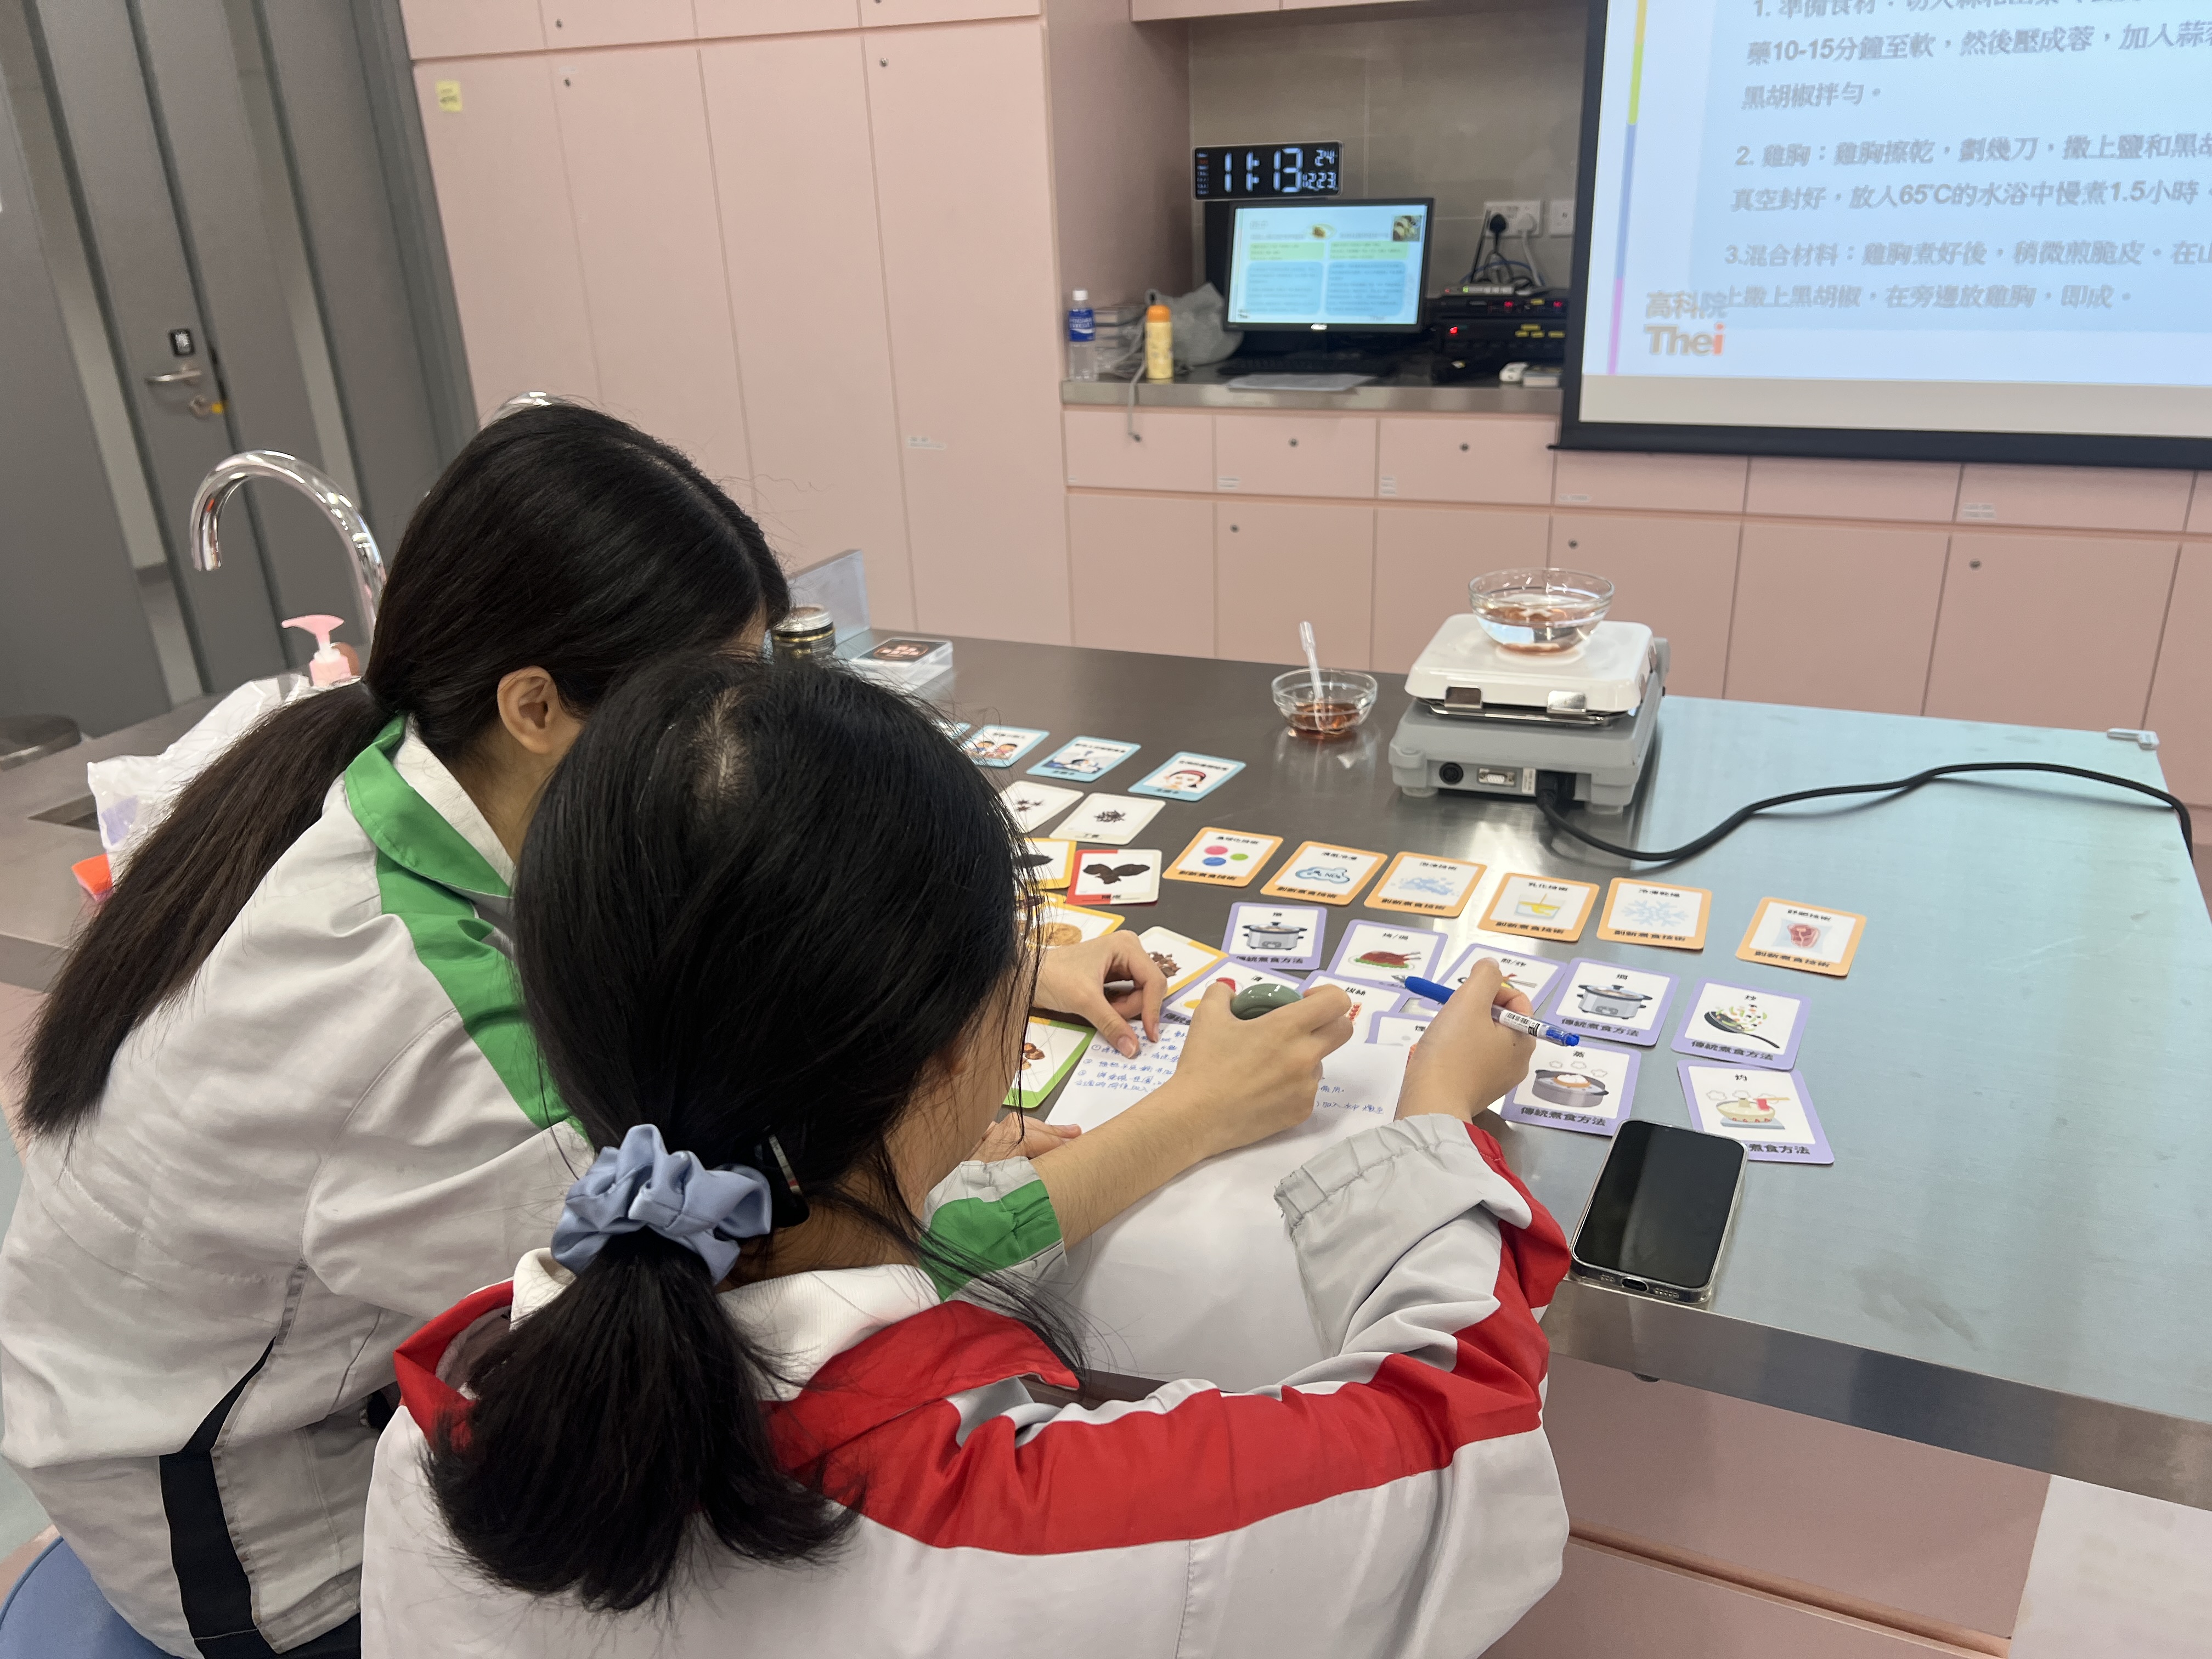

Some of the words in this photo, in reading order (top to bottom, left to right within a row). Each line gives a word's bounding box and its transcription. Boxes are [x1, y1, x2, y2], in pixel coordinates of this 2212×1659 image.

[1561, 1018, 1640, 1037] 傳統煮食方法
[1691, 1040, 1775, 1062] 傳統煮食方法
[1520, 1107, 1607, 1126] 傳統煮食方法
